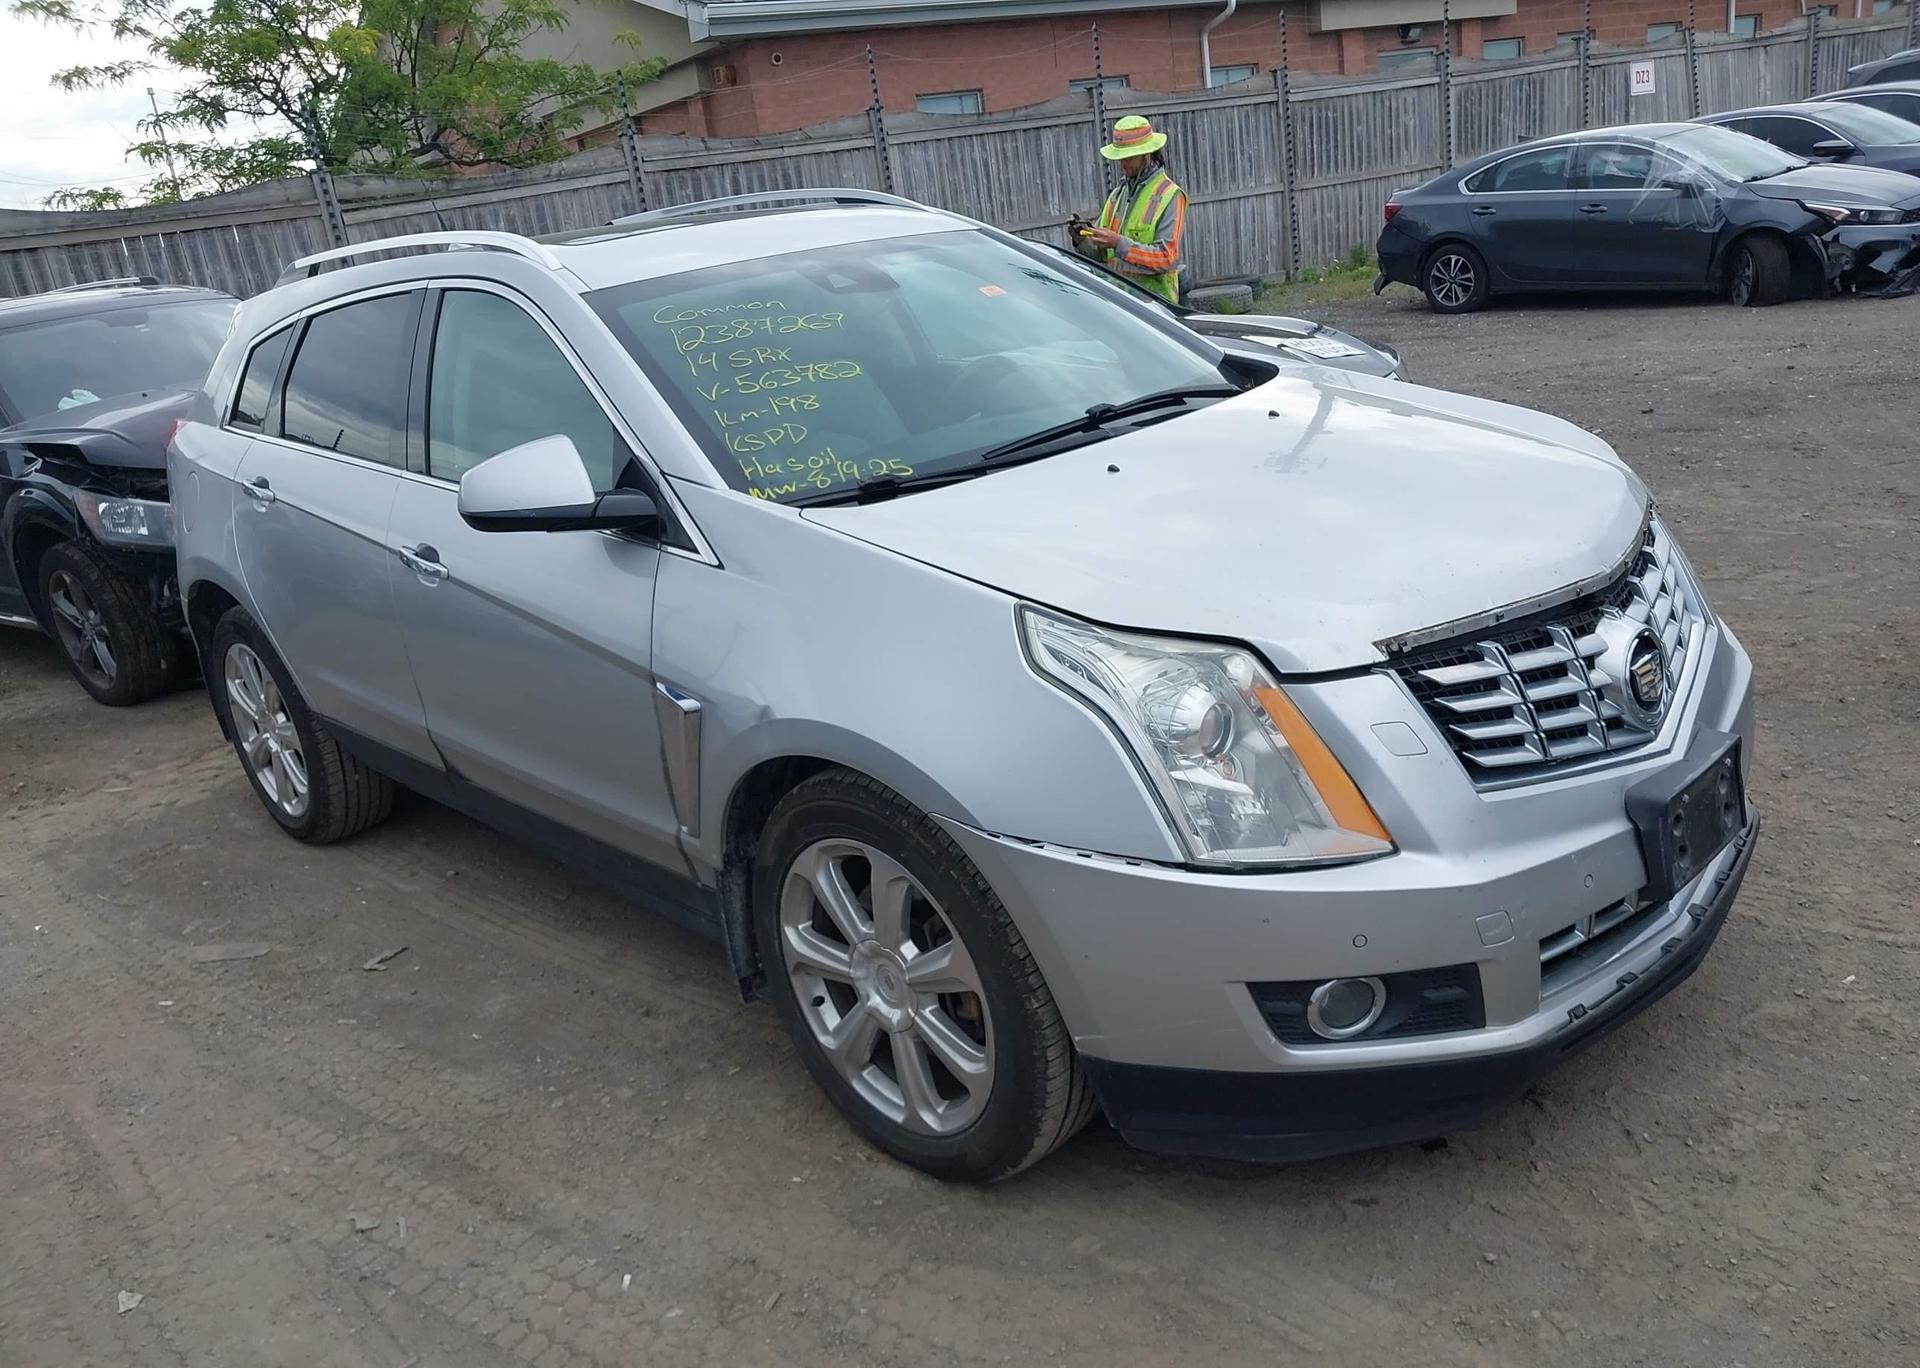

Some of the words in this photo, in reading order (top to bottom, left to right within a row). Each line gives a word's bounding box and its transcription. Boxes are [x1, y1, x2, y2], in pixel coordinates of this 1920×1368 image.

[1635, 70, 1650, 84] DZ3
[653, 300, 787, 324] Common
[671, 312, 844, 355] 12387269
[686, 351, 719, 377] 14
